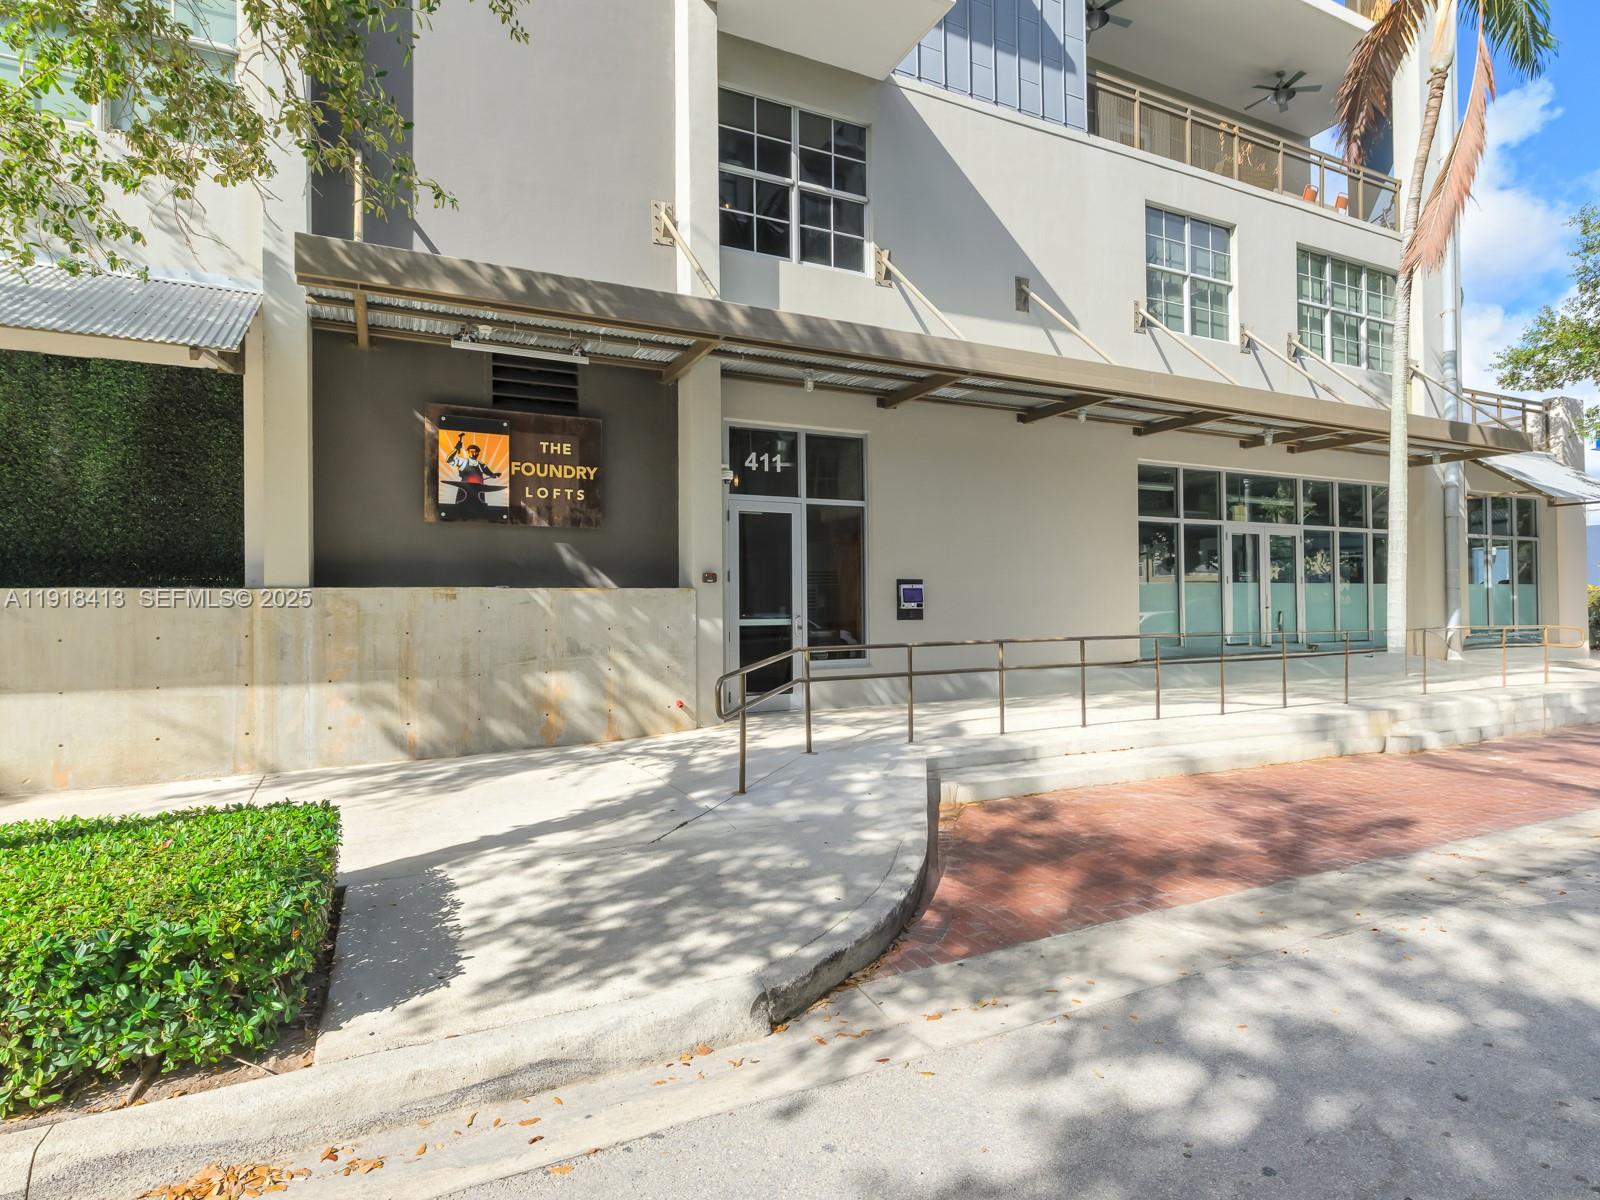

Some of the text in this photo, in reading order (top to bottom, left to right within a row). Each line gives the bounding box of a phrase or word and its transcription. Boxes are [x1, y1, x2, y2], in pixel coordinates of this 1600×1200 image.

[540, 441, 572, 455] THE
[511, 461, 598, 481] FOUNDRY
[744, 452, 782, 473] 411
[525, 486, 585, 501] LOFTS
